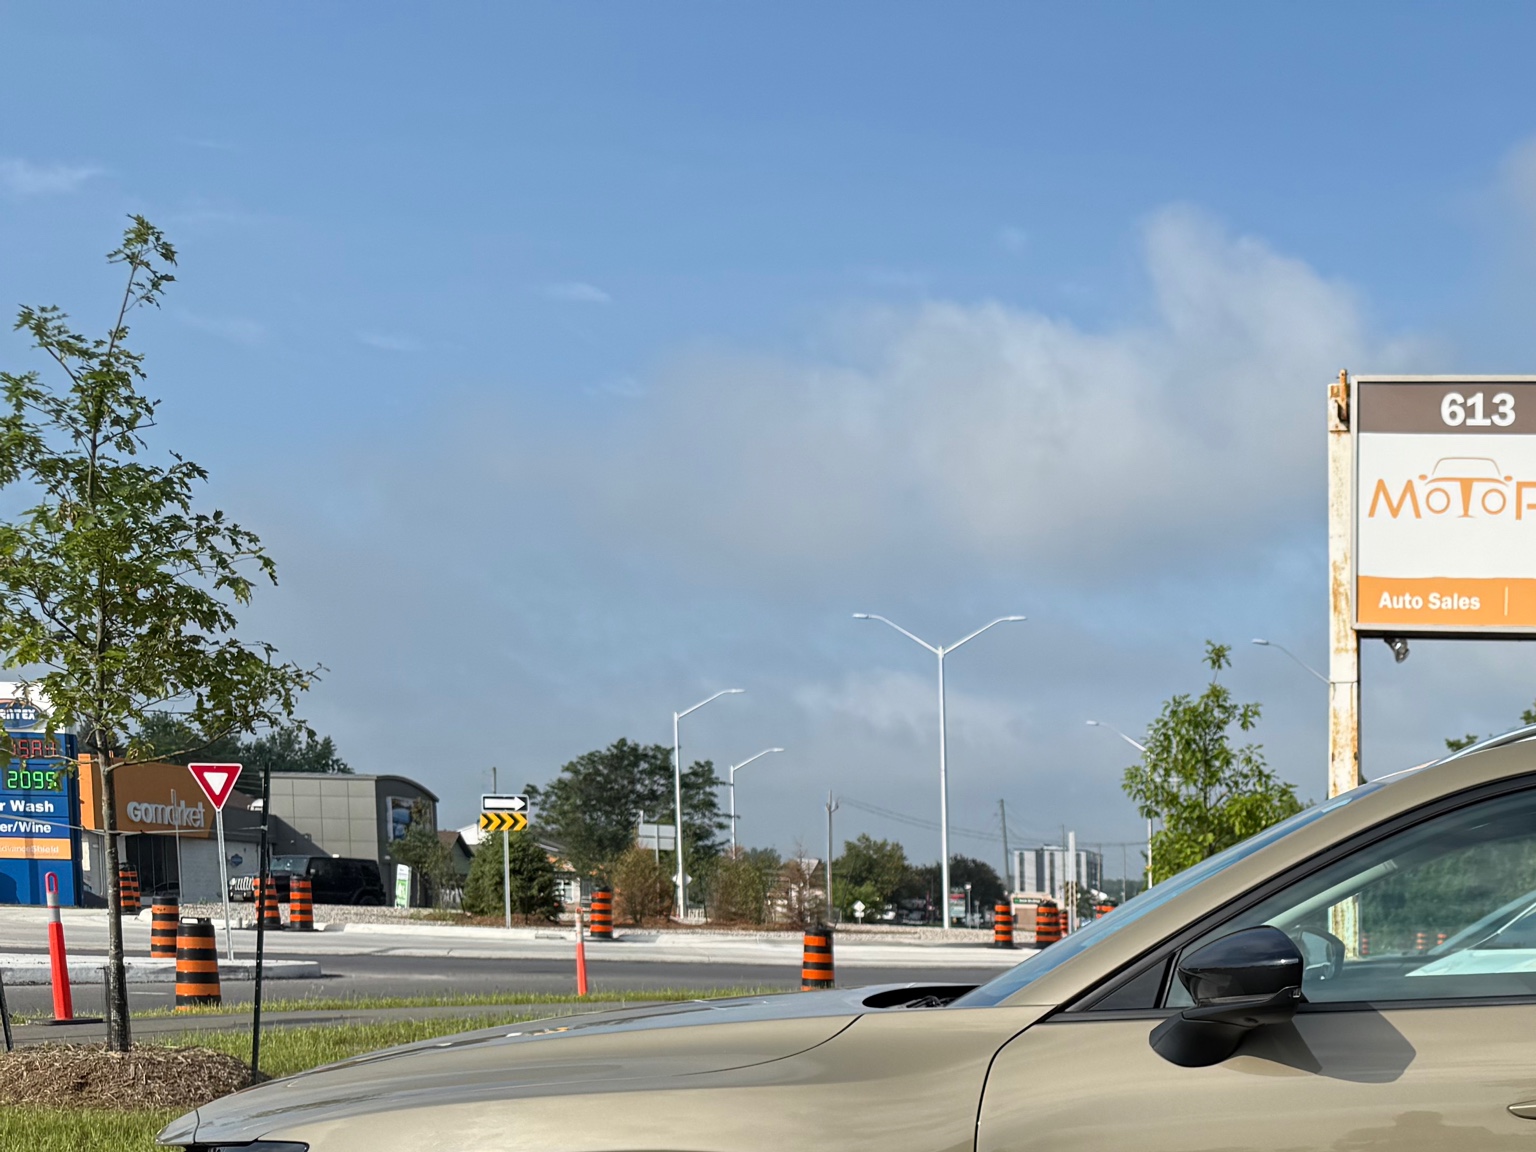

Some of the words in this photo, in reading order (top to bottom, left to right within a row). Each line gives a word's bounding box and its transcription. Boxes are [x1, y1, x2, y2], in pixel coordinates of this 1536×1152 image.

[1440, 392, 1516, 427] 613
[1378, 591, 1424, 609] Auto
[1427, 592, 1481, 610] Sales
[10, 799, 54, 813] Wash
